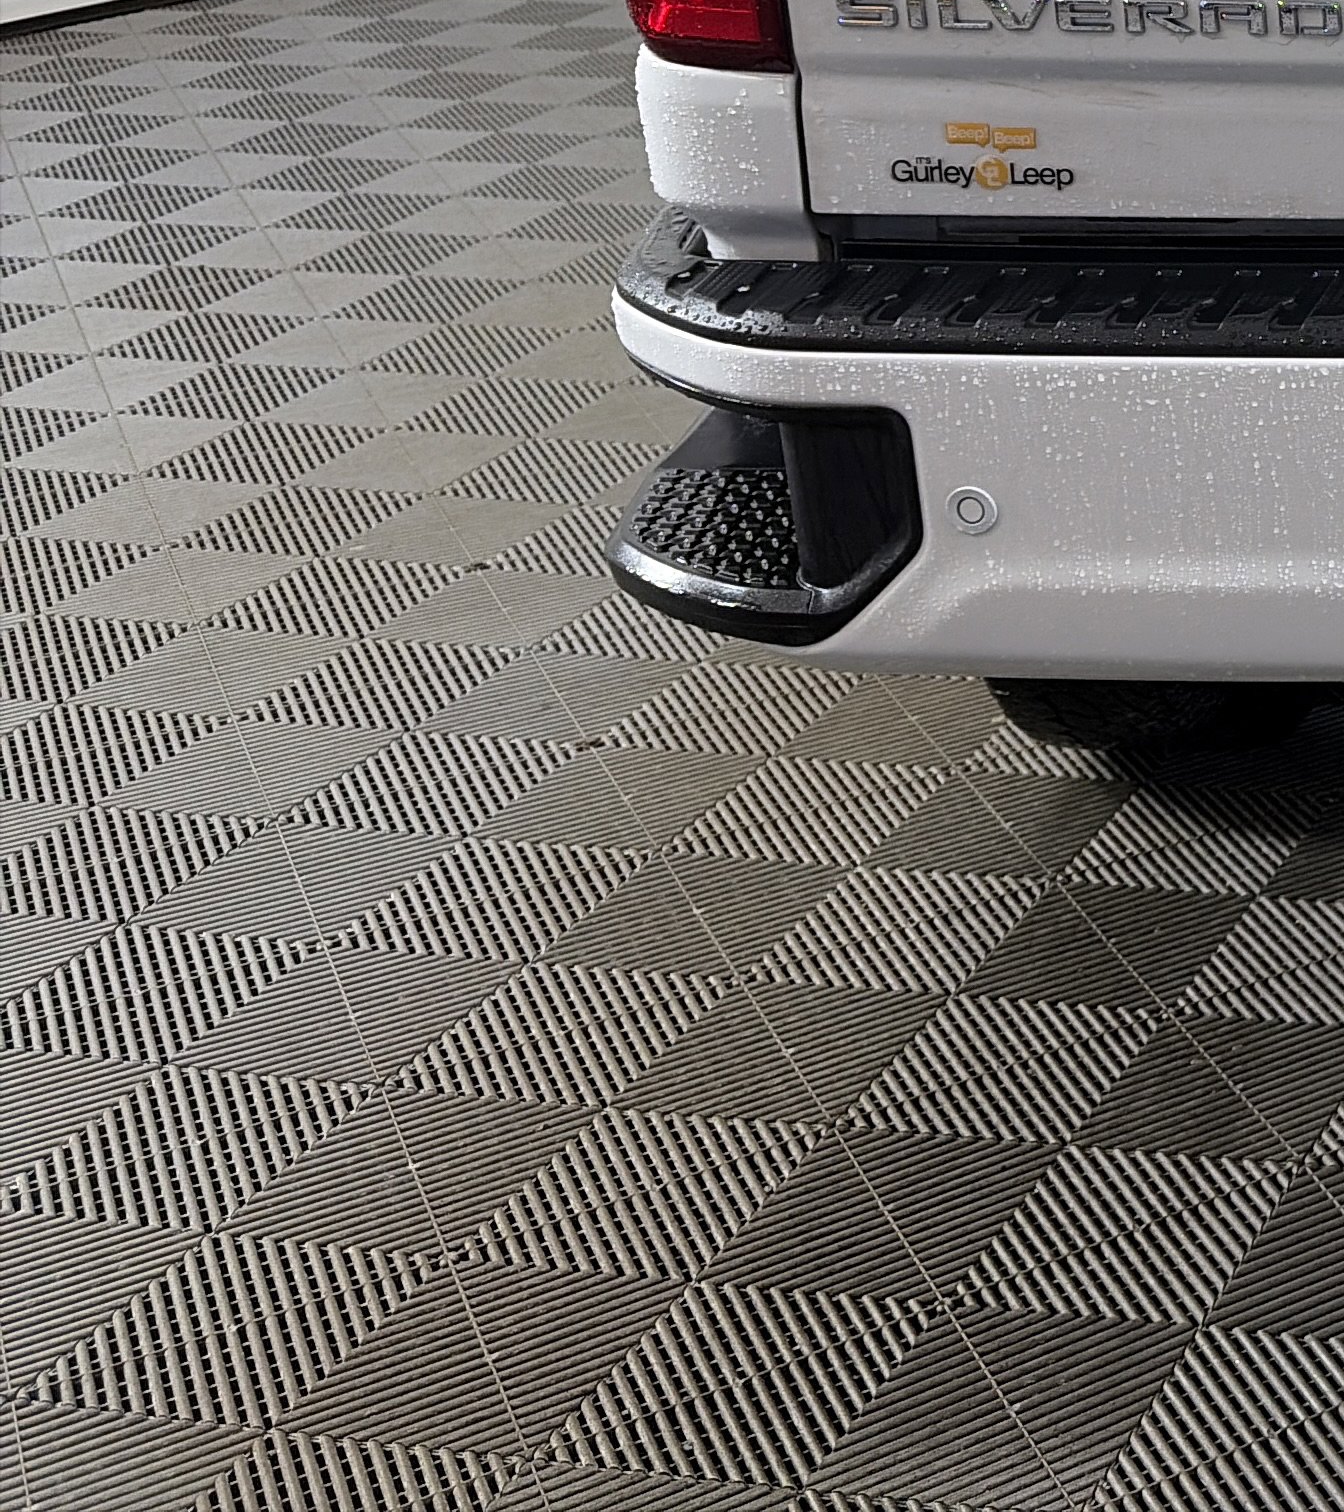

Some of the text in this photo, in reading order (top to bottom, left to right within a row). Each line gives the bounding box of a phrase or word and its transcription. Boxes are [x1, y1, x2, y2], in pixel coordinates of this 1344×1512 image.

[949, 124, 988, 143] Beep!
[994, 131, 1035, 146] Beep!
[891, 158, 975, 189] Gurley
[1010, 162, 1074, 190] Leep
